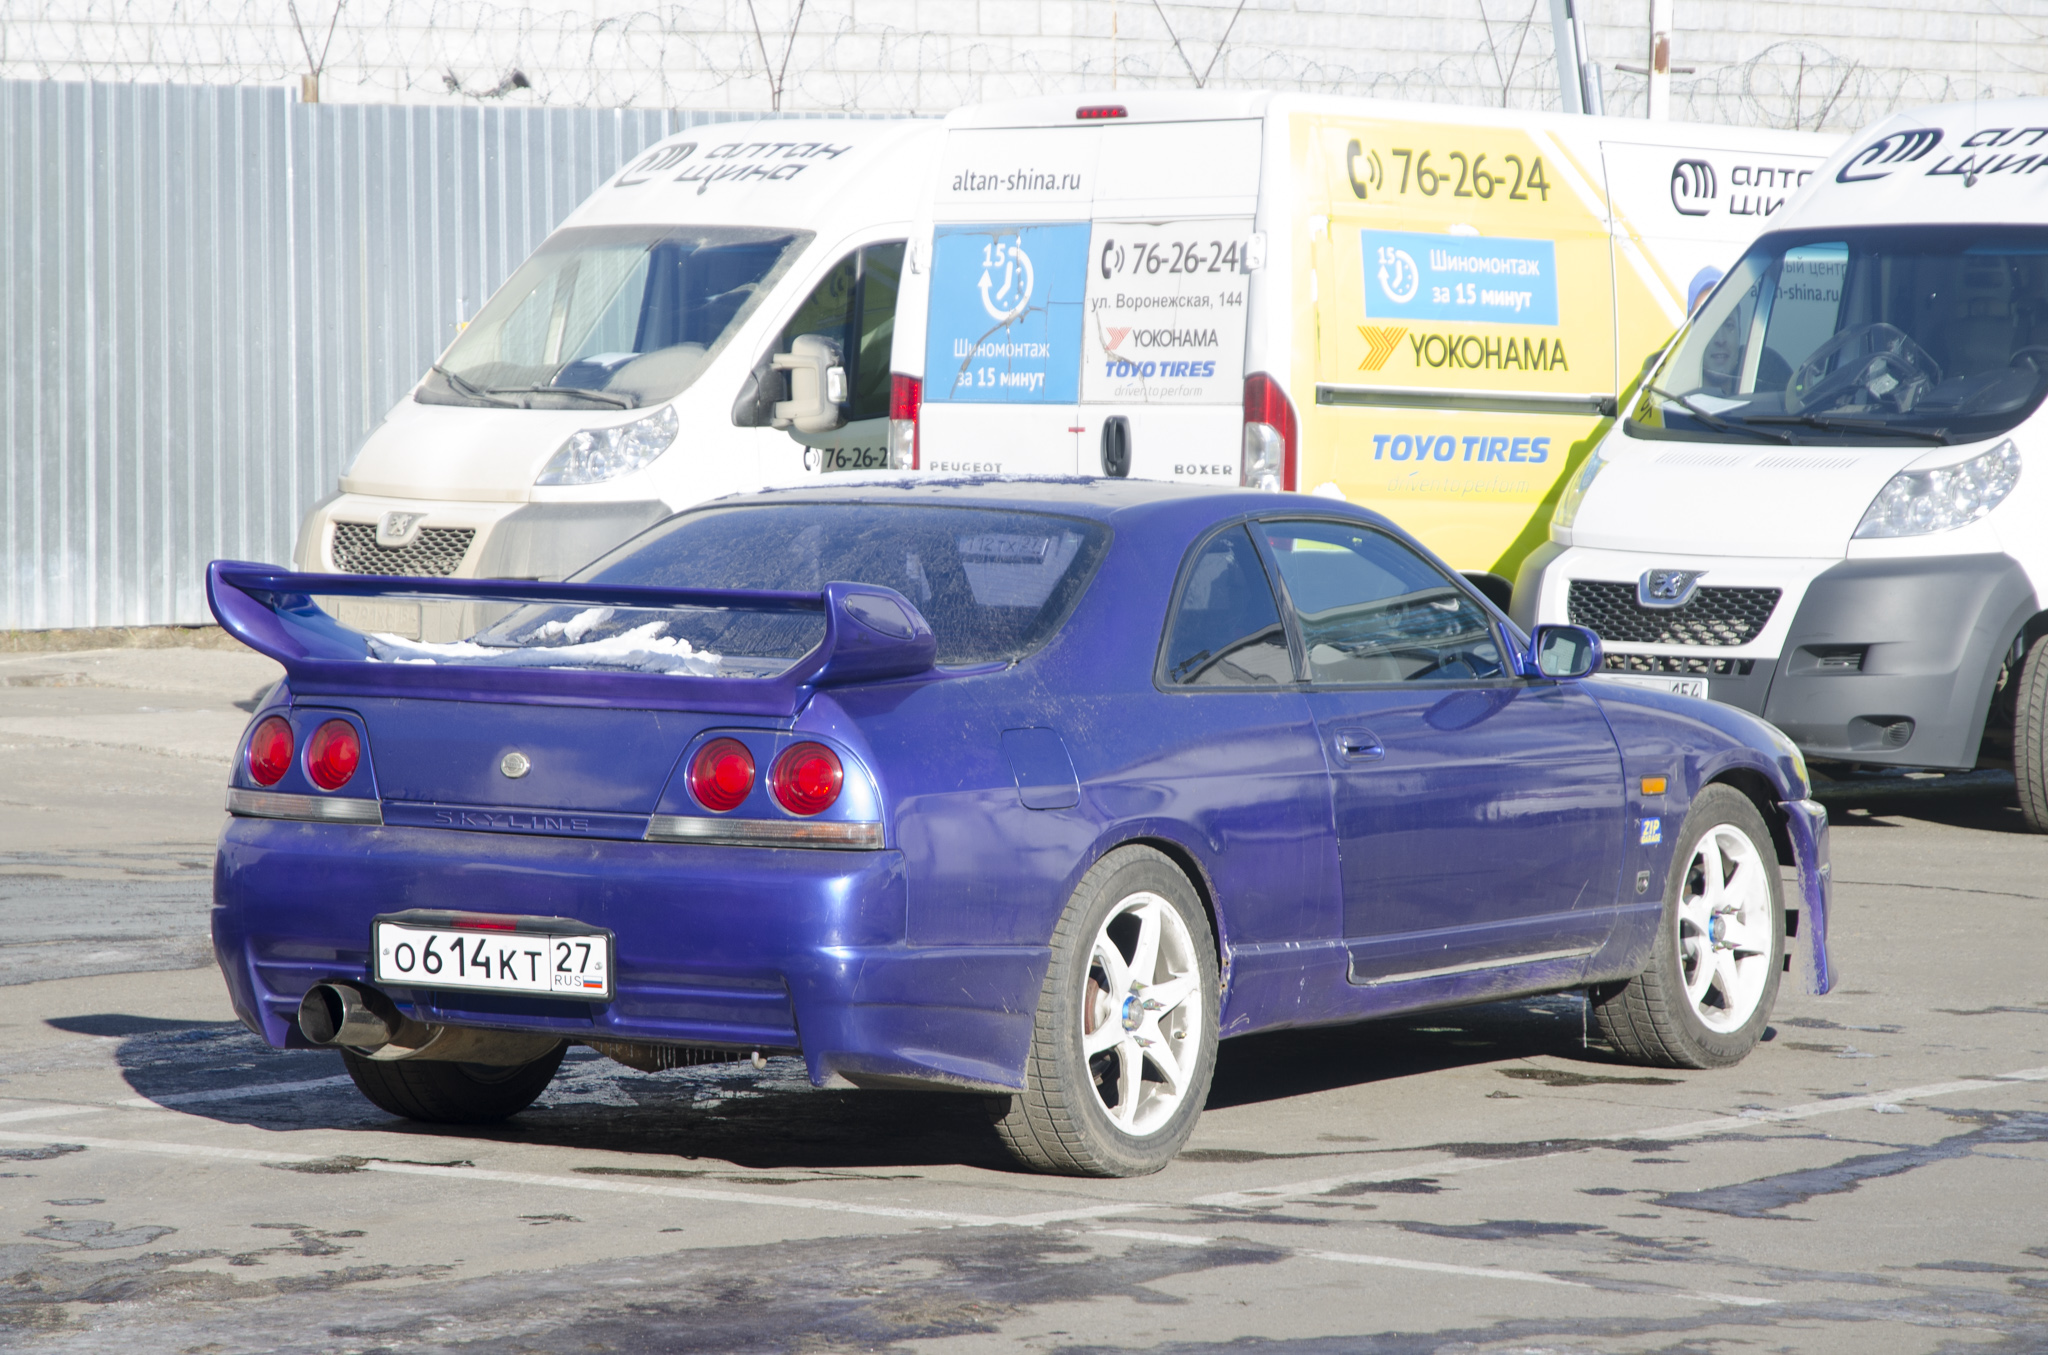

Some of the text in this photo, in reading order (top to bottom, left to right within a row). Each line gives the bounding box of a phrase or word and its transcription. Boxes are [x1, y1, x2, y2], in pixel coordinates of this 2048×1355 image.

[952, 168, 1081, 191] altan-shina.ru
[1391, 148, 1551, 202] 76-26-24
[982, 243, 1005, 267] 15
[1133, 240, 1240, 274] 76-26-24
[1377, 246, 1396, 265] 15
[1429, 248, 1541, 276] Шиномонтаж
[1091, 291, 1243, 312] ул. Воронежская, 144
[1432, 283, 1533, 312] за 15 минут
[954, 338, 1051, 358] Шиномонтаж
[1132, 328, 1219, 348] YOKOHAMA
[1409, 333, 1570, 372] YOKOHAMA
[957, 366, 1046, 392] за 15 минут
[1105, 360, 1216, 378] TOYO TIRES
[1372, 433, 1552, 464] TOYO TIRES
[929, 461, 1003, 474] PEUGEOT
[1174, 463, 1233, 476] BOXER
[433, 811, 590, 832] SKYLINE
[1642, 818, 1660, 836] ZIP
[555, 942, 592, 974] 27
[554, 974, 582, 987] RUS
